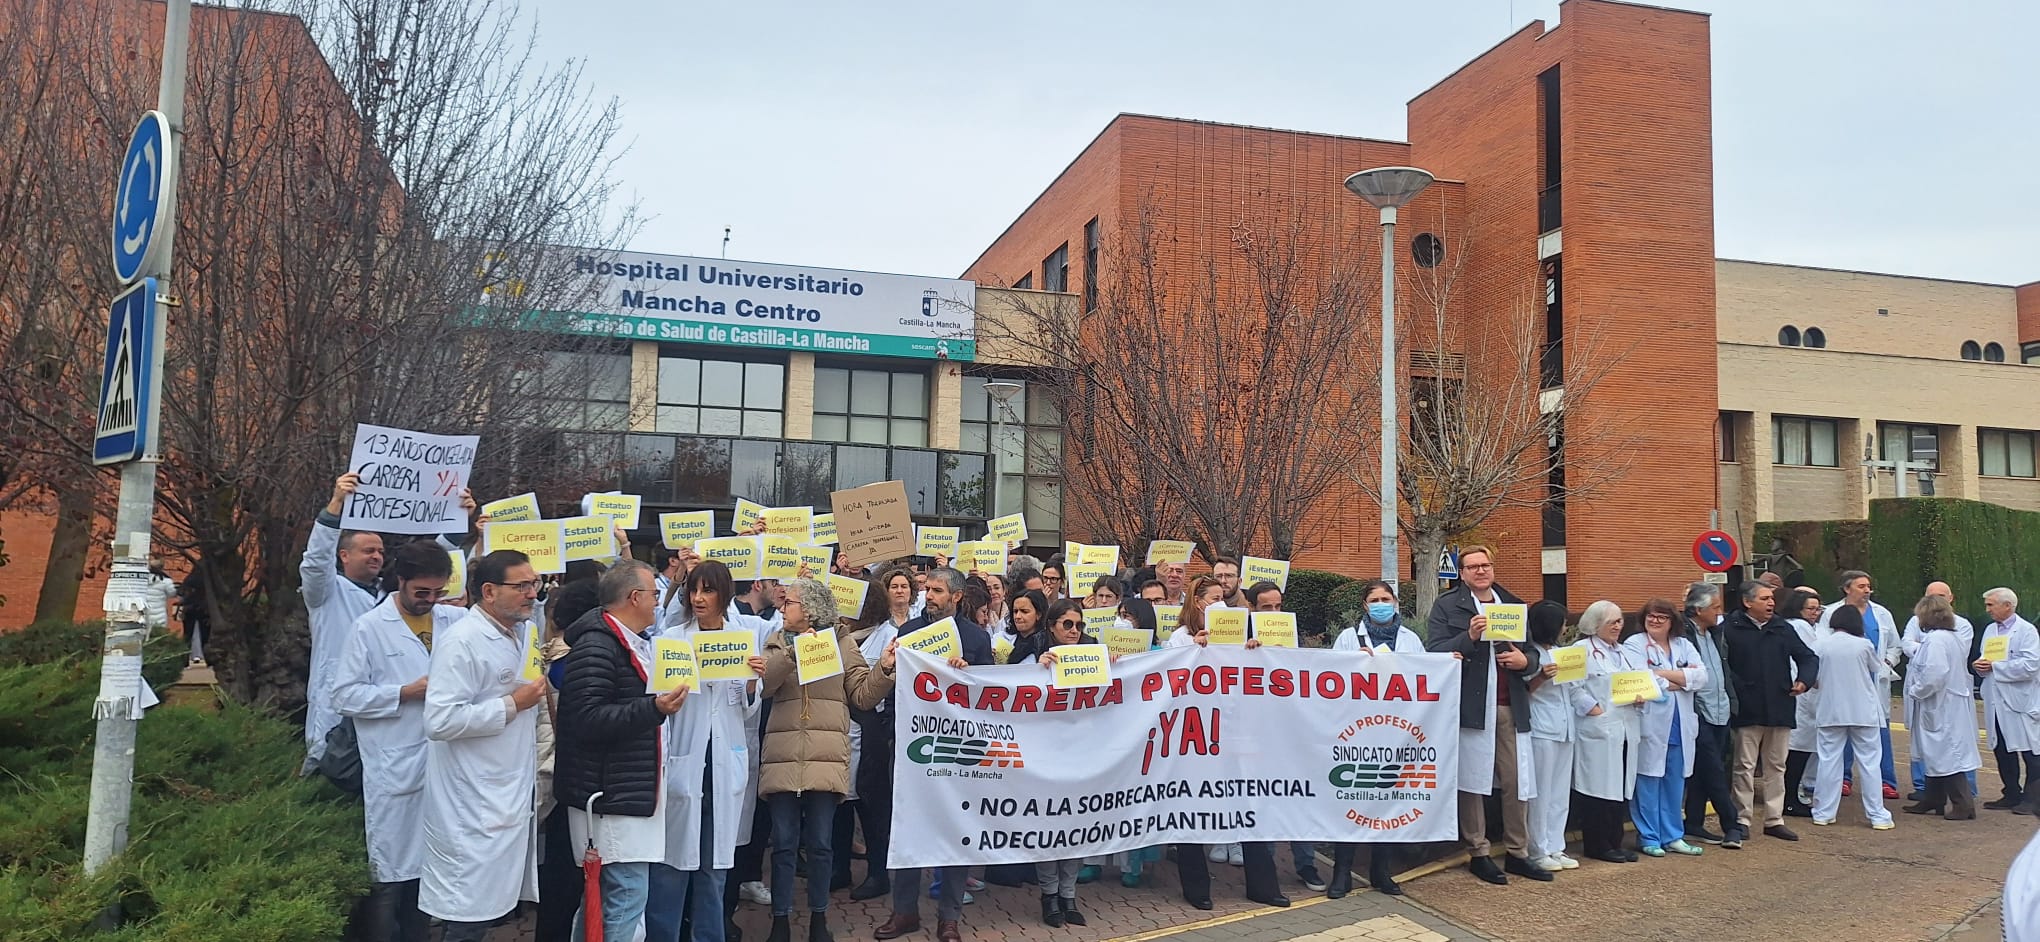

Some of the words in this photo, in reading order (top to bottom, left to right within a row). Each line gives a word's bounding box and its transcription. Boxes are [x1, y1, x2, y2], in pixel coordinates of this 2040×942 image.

[576, 255, 688, 282] Hospital
[699, 264, 864, 296] Universitario
[622, 289, 726, 315] Mancha
[735, 298, 821, 323] Centro
[899, 317, 934, 328] Castilla-La
[936, 320, 961, 329] Mancha
[637, 320, 657, 337] de
[660, 321, 704, 341] Salud
[708, 325, 727, 342] de
[730, 326, 810, 347] Castilla-La
[813, 332, 870, 351] Mancha
[364, 433, 389, 455] 13
[388, 436, 428, 461] AÑOS
[357, 461, 420, 493] CARRERA
[433, 470, 459, 497] YA
[349, 492, 457, 523] PROFESIONAL
[490, 503, 529, 519] ¡Estatuo
[597, 501, 632, 510] ¡Estatuo
[843, 502, 863, 513] HORA
[669, 521, 706, 530] ¡Estatuo
[771, 515, 801, 524] ¡Carrera
[993, 520, 1019, 531] ¡Estatuo
[565, 526, 604, 537] Estatuo
[672, 530, 703, 541] propio!
[765, 525, 808, 535] Profesional!
[997, 529, 1018, 539] propio!
[502, 532, 546, 544] ¡Carrera
[565, 536, 602, 550] propio!
[923, 533, 953, 541] ¡Estatuo
[768, 545, 798, 556] ¡Estatuo
[924, 543, 950, 551] propio!
[706, 548, 751, 559] ¡Estatuo
[768, 558, 797, 568] propio!
[1249, 563, 1282, 575] ¡Estatuo
[1216, 617, 1239, 627] ¡Carrera
[1489, 611, 1520, 621] ¡Estatuo
[1264, 619, 1289, 628] ¡Carrera
[1491, 622, 1517, 632] propio!
[1209, 628, 1244, 637] Profesional!
[1111, 634, 1141, 644] ¡Carrera
[699, 642, 748, 653] ¡Estatuo
[802, 640, 830, 654] ¡Carrera
[662, 649, 693, 661] ¡Estatuo
[1060, 653, 1100, 664] ¡Estatuo
[701, 655, 744, 668] propio!
[665, 665, 694, 679] propio!
[1064, 665, 1099, 677] propio!
[1617, 676, 1644, 687] ¡Carrera
[913, 671, 1124, 713] CARRERA
[1141, 665, 1440, 702] PROFESIONAL
[911, 714, 976, 738] SINDICATO
[976, 719, 1015, 741] MÉDICO
[1338, 725, 1355, 743] TU
[1355, 714, 1427, 744] PROFESIÓN
[1141, 706, 1221, 776] ¡YA!
[906, 735, 1025, 769] CESM
[1332, 745, 1393, 763] SINDICATO
[1395, 743, 1437, 763] MÉDICO
[926, 767, 952, 777] Castilla
[959, 769, 969, 778] La
[972, 770, 1003, 780] Mancha
[1328, 763, 1437, 789] CESM
[979, 797, 1017, 818] NO
[1022, 798, 1040, 817] A
[1045, 797, 1073, 817] LA
[1077, 779, 1193, 815] SOBRECARGA
[1198, 778, 1316, 799] ASISTENCIAL
[1336, 789, 1389, 801] Castilla-La
[1391, 790, 1431, 801] Mancha
[1345, 806, 1424, 831] DEFIÉNDELA
[978, 821, 1116, 851] ADECUACIÓN
[1118, 817, 1144, 839] DE
[1146, 809, 1257, 834] PLANTILLAS
